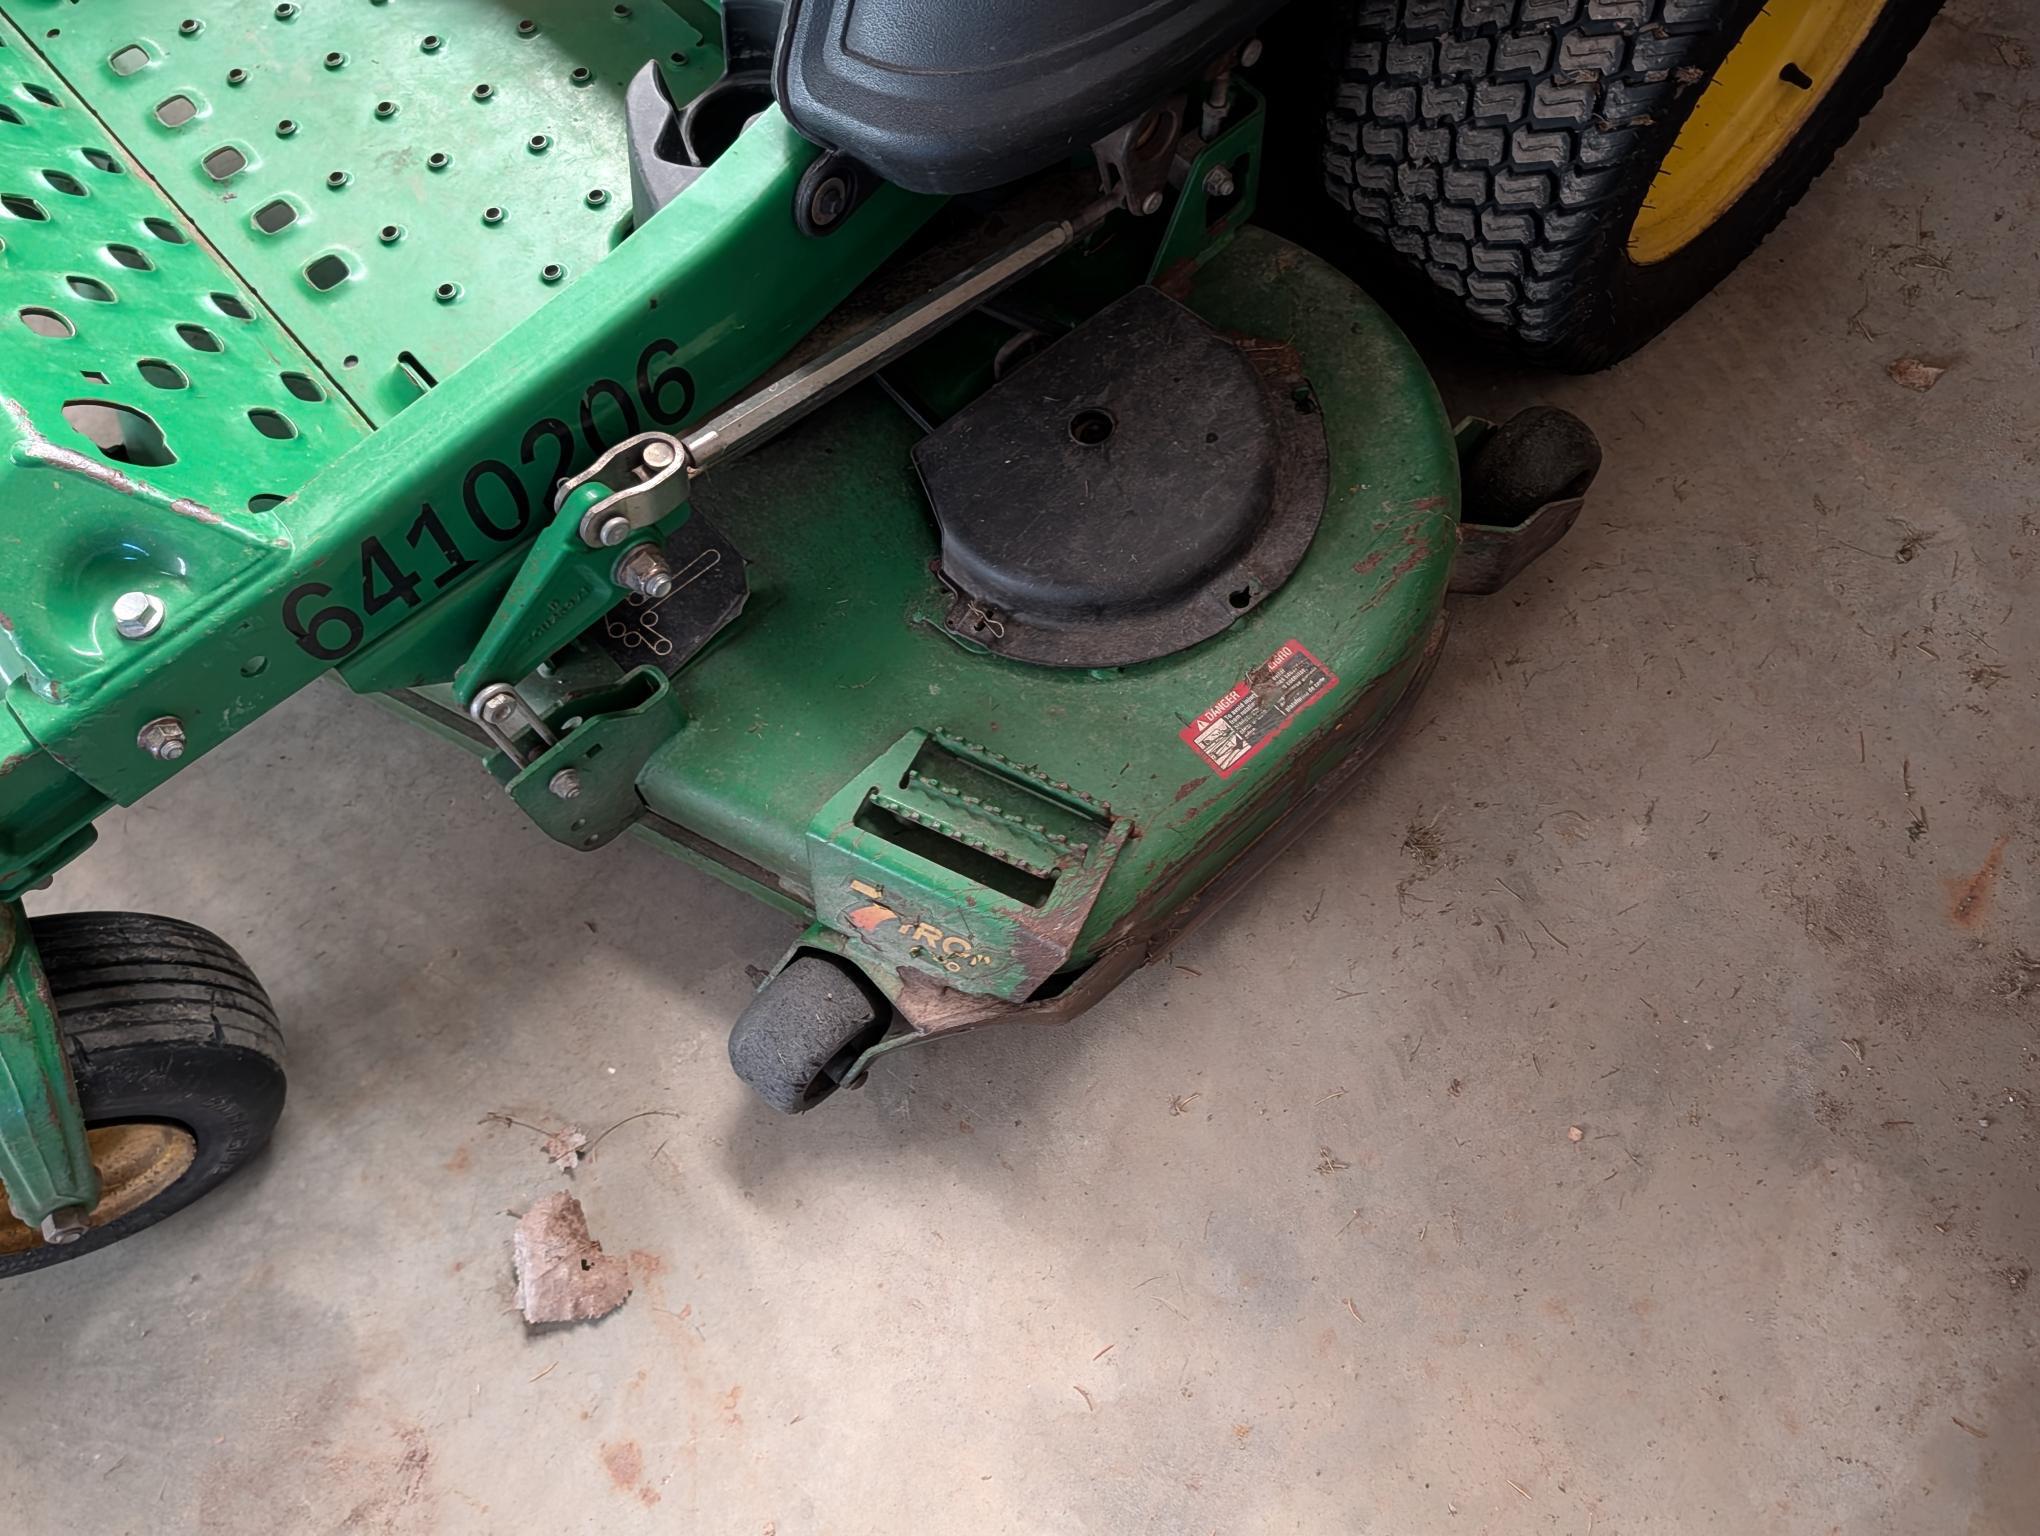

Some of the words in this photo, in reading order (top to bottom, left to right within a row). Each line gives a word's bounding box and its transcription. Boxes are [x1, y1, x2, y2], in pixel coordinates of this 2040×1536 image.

[282, 338, 695, 661] 6410206
[1206, 690, 1241, 721] DANGER
[1223, 712, 1232, 720] To
[1230, 702, 1244, 715] avoid
